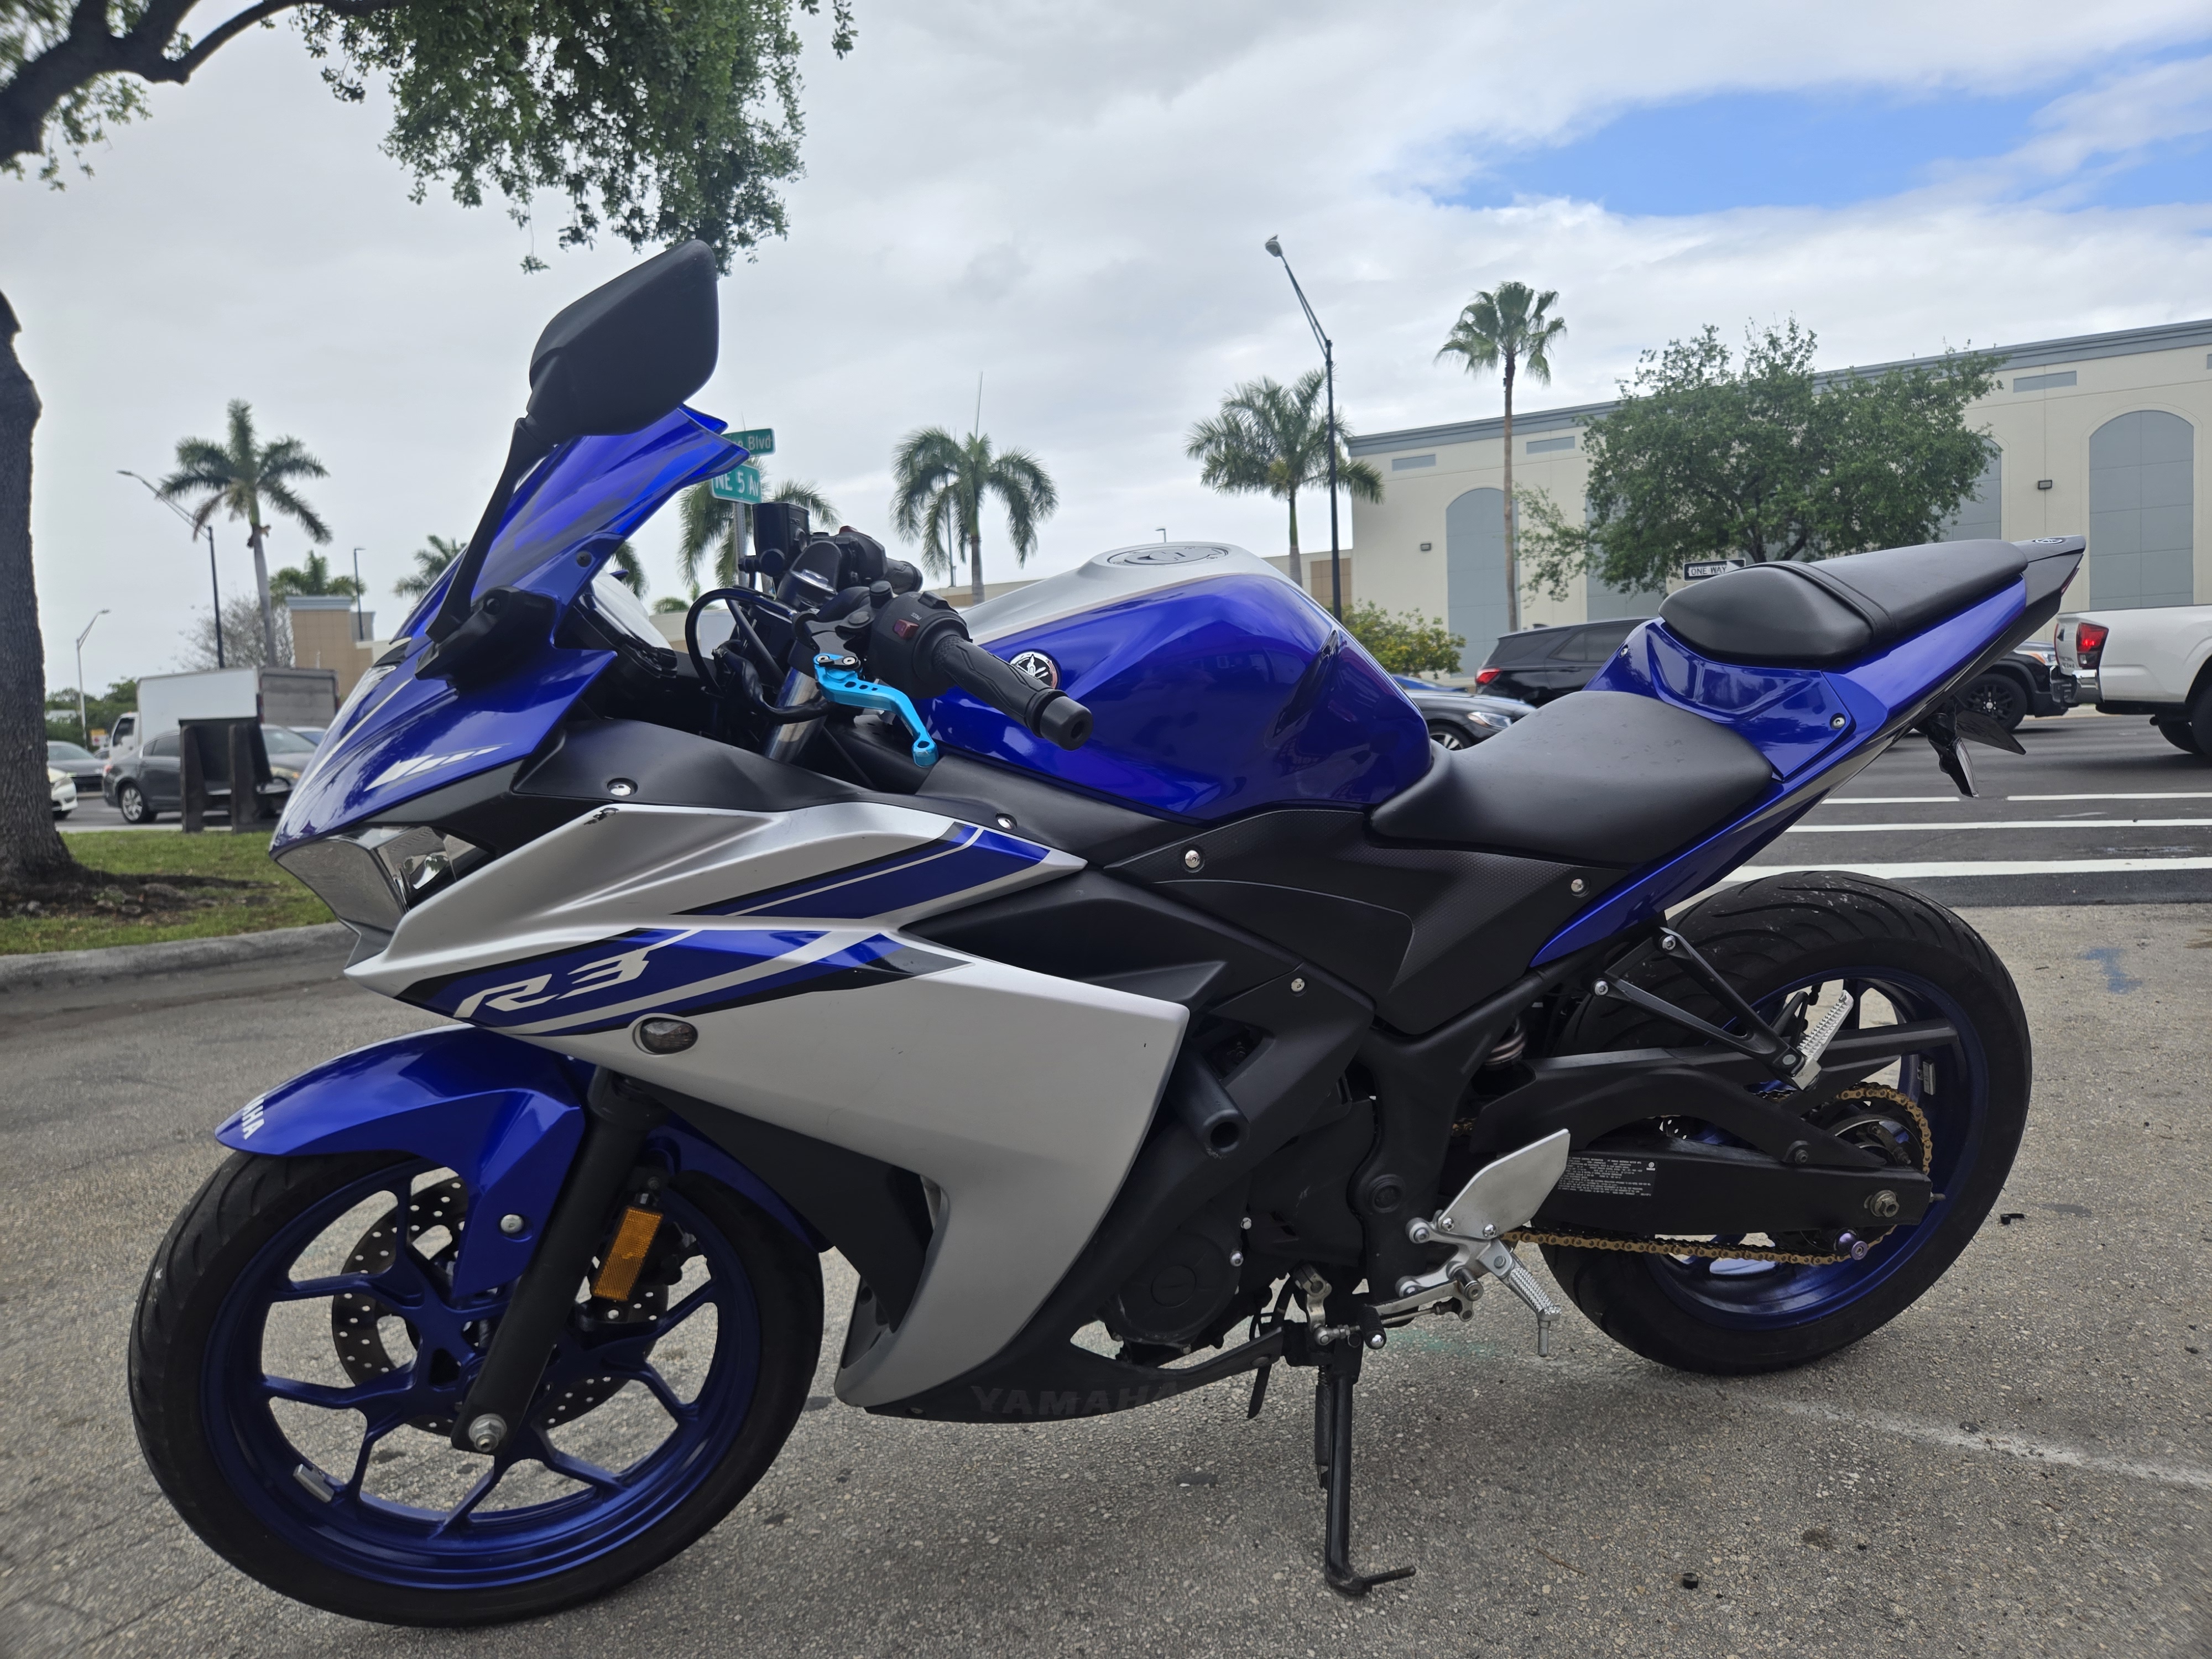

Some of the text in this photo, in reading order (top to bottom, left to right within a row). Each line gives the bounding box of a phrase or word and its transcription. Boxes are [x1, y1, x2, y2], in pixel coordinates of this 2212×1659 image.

[748, 434, 771, 451] Blvd
[715, 472, 733, 491] NE
[737, 471, 745, 493] 5
[1710, 566, 1727, 574] WAY
[453, 947, 649, 1018] R3
[971, 1381, 1178, 1416] YAMAHA
